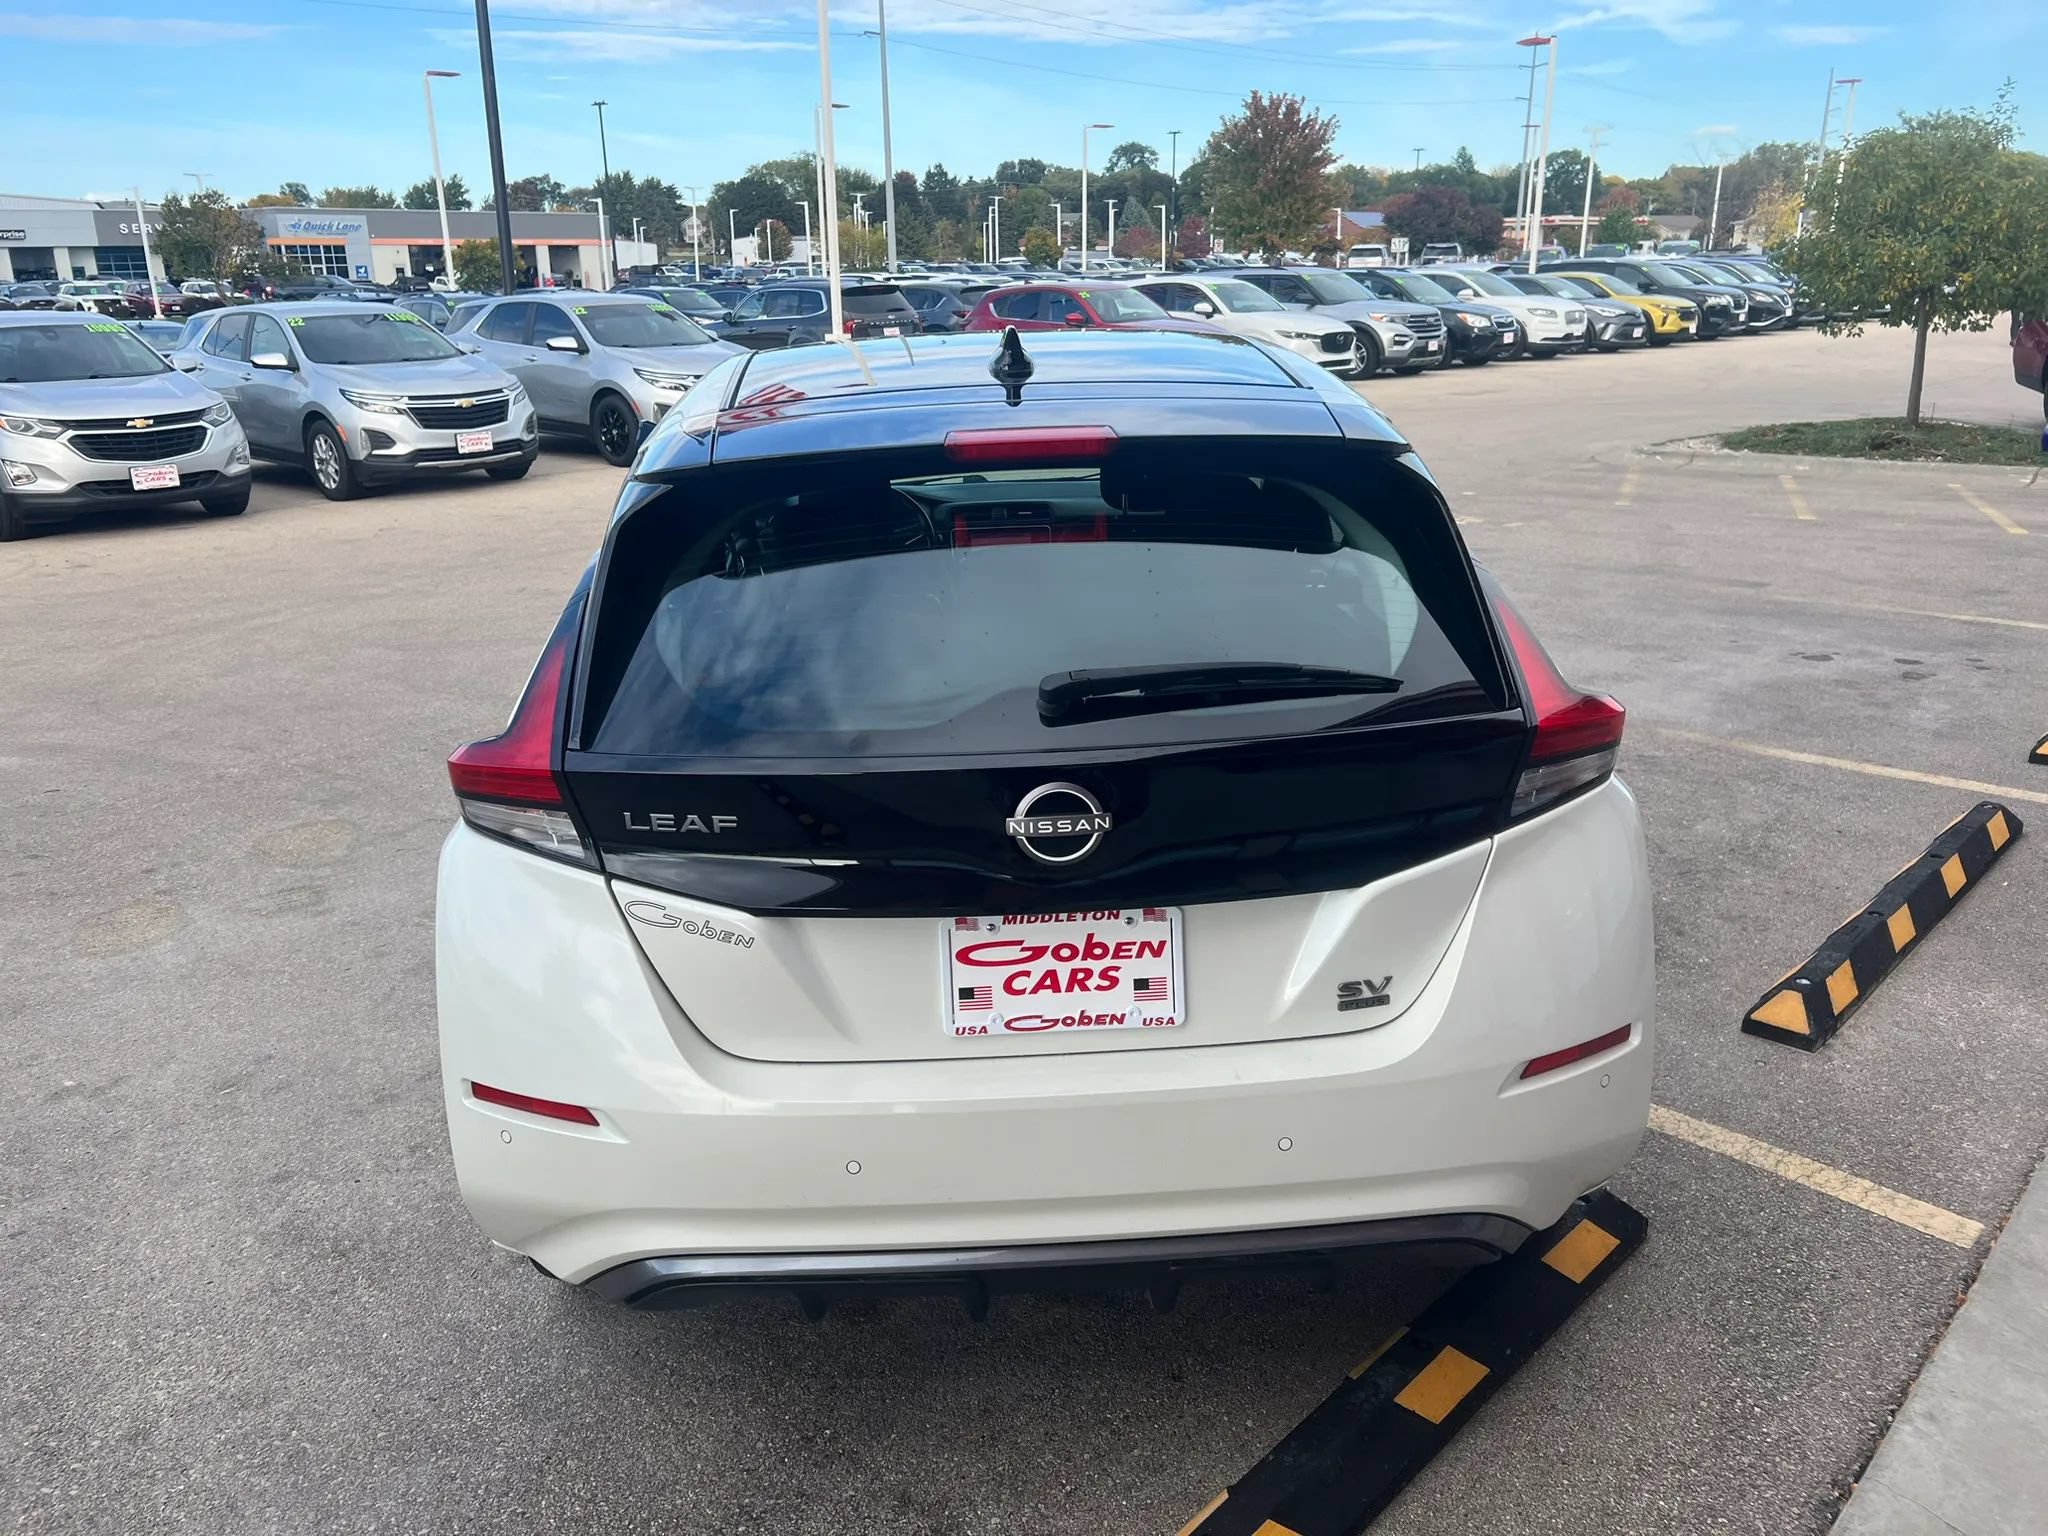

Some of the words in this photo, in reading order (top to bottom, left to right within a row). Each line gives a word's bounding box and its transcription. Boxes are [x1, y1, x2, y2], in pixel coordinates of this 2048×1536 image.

[303, 221, 334, 232] Quick
[336, 221, 362, 232] Lane
[287, 317, 306, 327] 22
[623, 812, 738, 833] LEAF
[1009, 816, 1110, 834] NISSAN
[1001, 910, 1121, 926] MIDDLETON
[1002, 965, 1123, 996] CARS
[1336, 975, 1394, 999] SV
[1343, 999, 1386, 1010] PLUS
[1142, 1016, 1177, 1027] USA
[955, 1025, 989, 1036] USA
